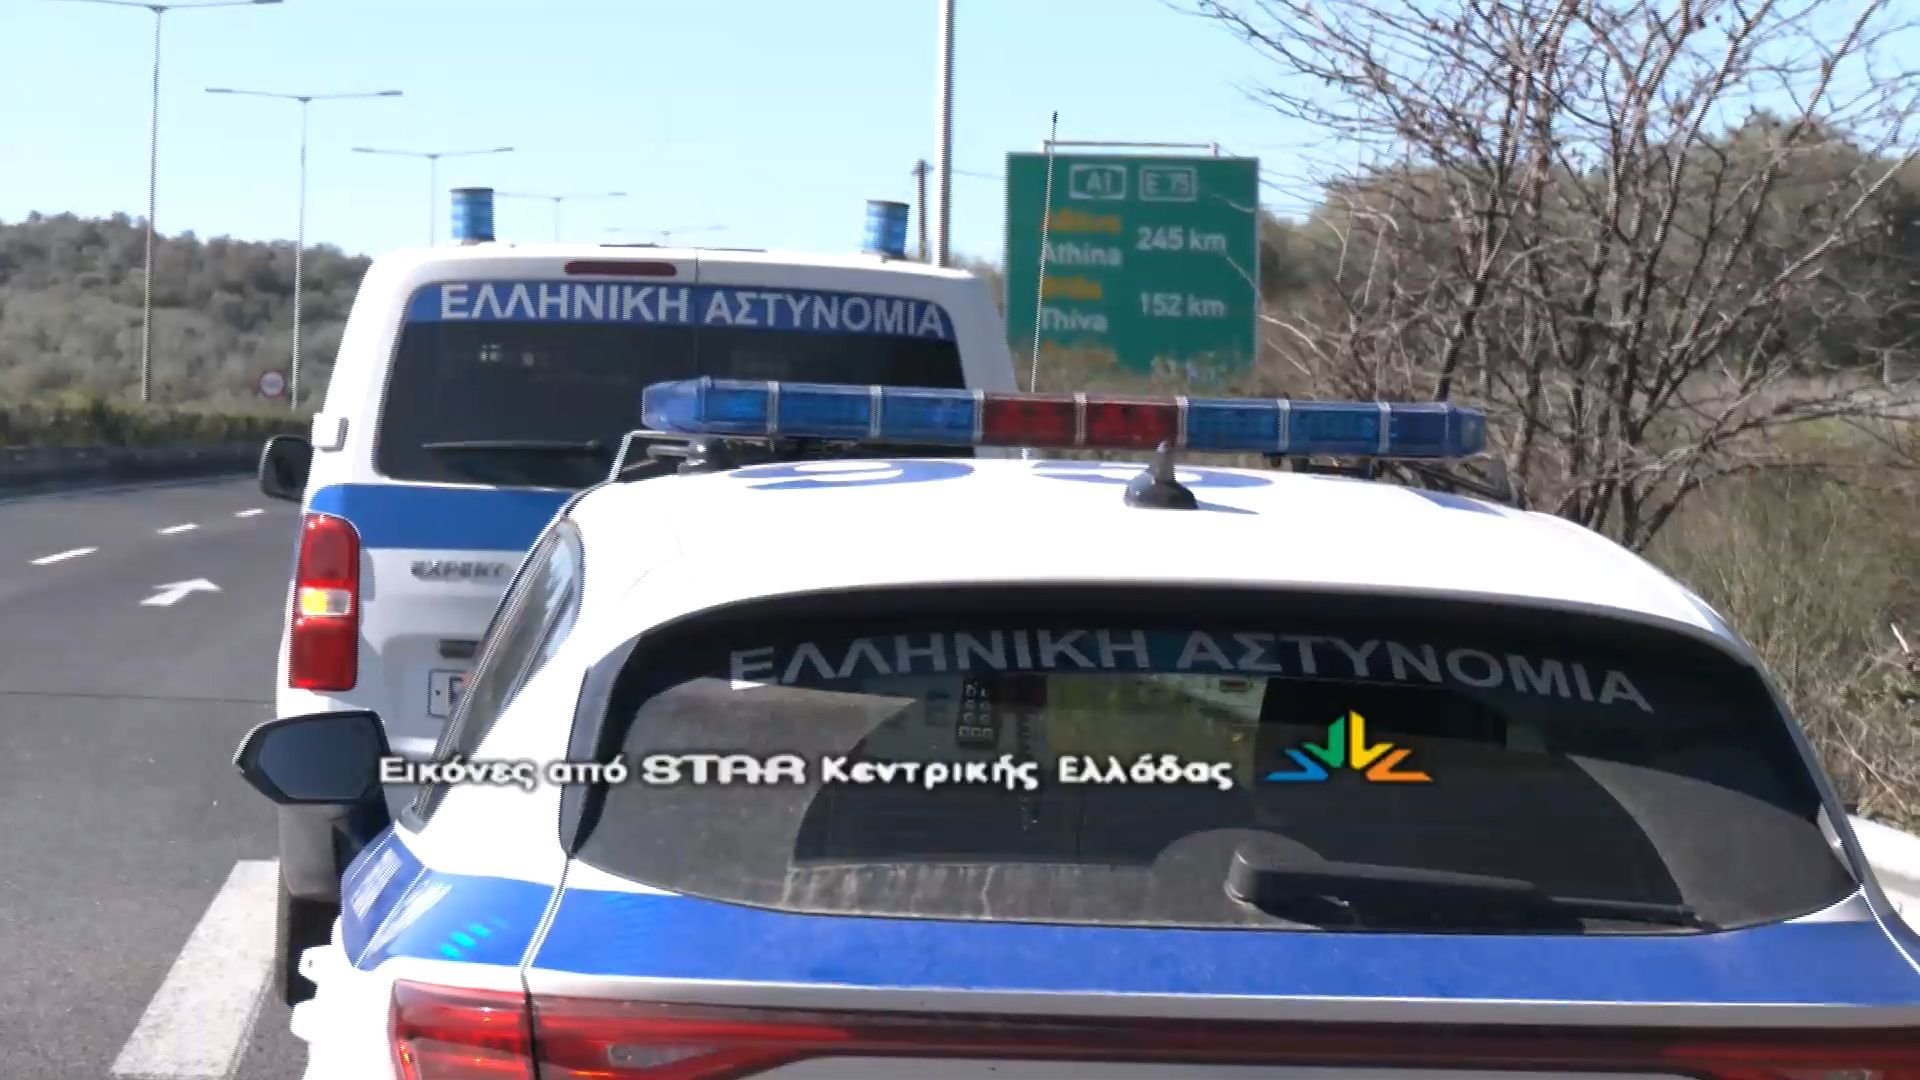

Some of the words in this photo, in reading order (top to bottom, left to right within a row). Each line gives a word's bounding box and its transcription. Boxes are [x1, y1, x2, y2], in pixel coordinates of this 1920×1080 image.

[1169, 172, 1190, 194] 75
[1136, 226, 1184, 250] 245
[1188, 228, 1227, 252] km
[440, 283, 690, 323] ΕΛΛΗΝΙΚΗ
[704, 290, 946, 338] ΑΣΤΥΝΟΜΙΑ
[1140, 292, 1182, 317] 152
[1187, 293, 1227, 318] km
[729, 628, 1149, 691] ΕΛΛΗΝΙΚΗ
[1175, 629, 1655, 714] ΑΣΤΥΝΟΜΙΑ
